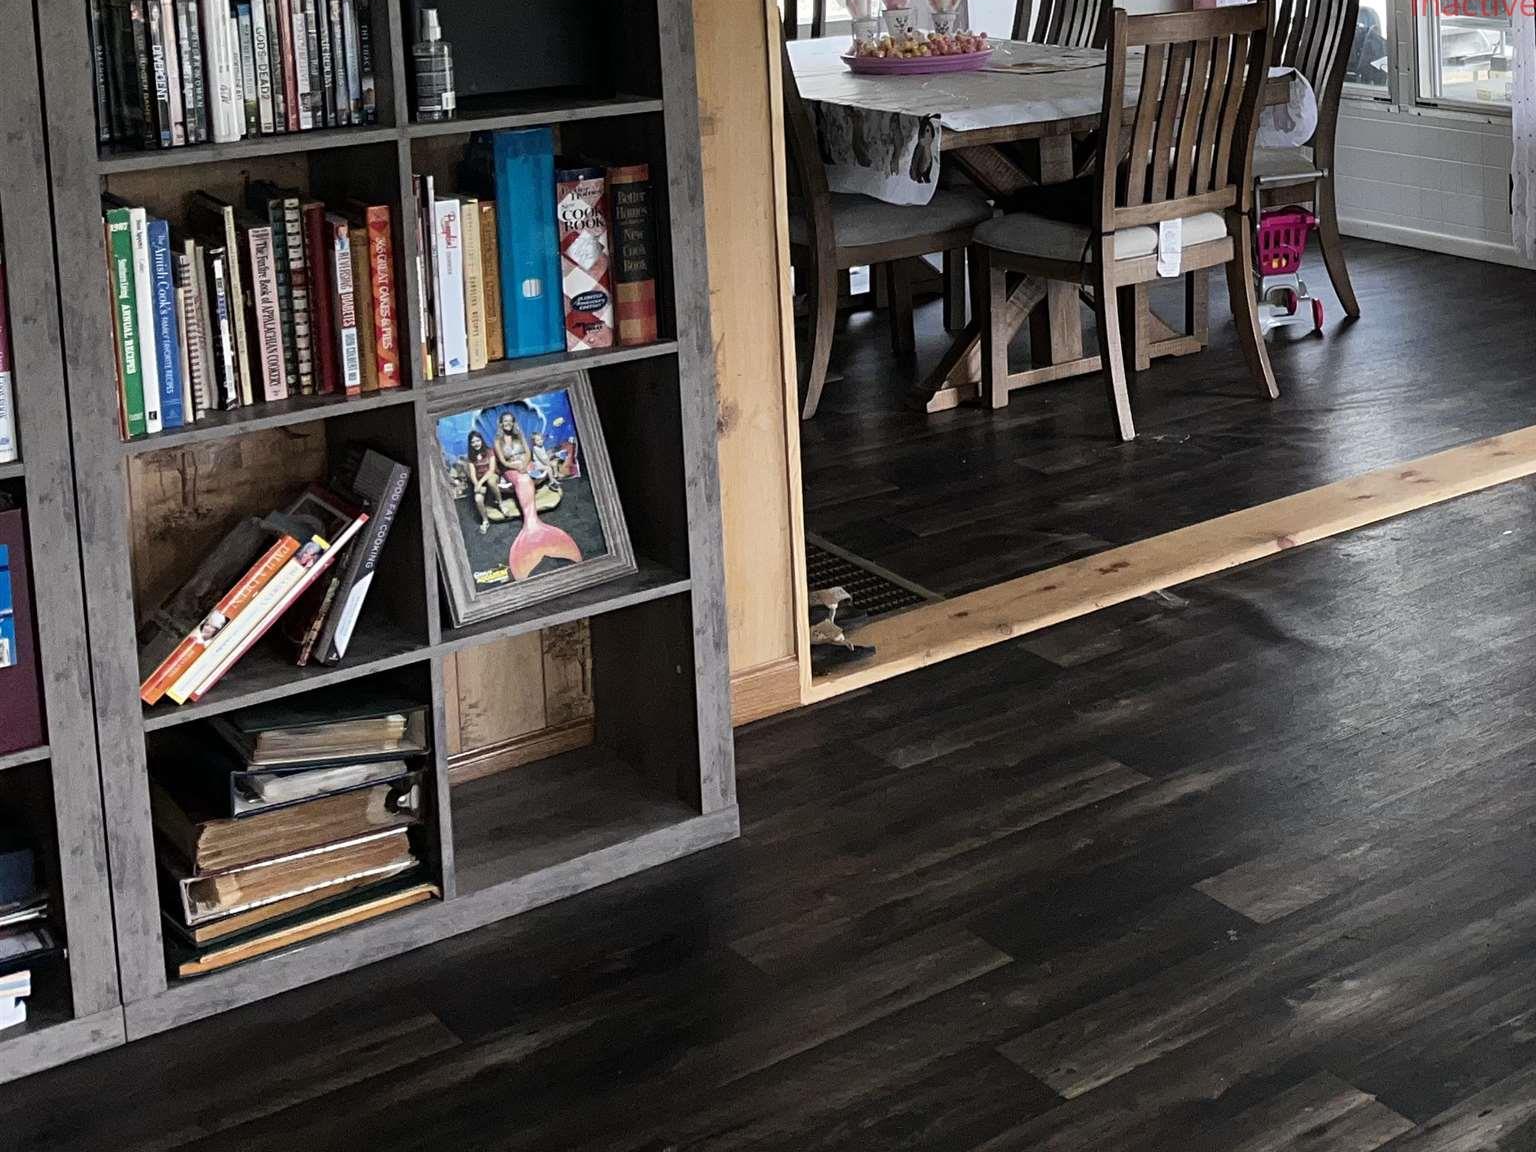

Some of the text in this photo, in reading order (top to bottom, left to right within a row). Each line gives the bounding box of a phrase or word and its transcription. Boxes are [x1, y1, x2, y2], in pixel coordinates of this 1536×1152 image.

[153, 44, 169, 103] DIVERGENT
[616, 207, 647, 219] Homes
[617, 191, 646, 202] Better
[562, 208, 604, 220] COOK
[564, 218, 606, 232] BOOK
[623, 244, 647, 257] Cook
[624, 229, 644, 240] New
[154, 245, 170, 279] Amish
[623, 259, 648, 273] Book
[157, 281, 173, 315] Cook's
[337, 251, 356, 327] REVERSING DIABETES
[375, 237, 393, 349] 365 GREAT CAKES & PIES
[255, 242, 281, 387] The Foxfire Book of APPALACHIAN COOKERY
[121, 304, 137, 374] ANNUAL RECIPES
[365, 472, 408, 569] GOOD FAT COOKING
